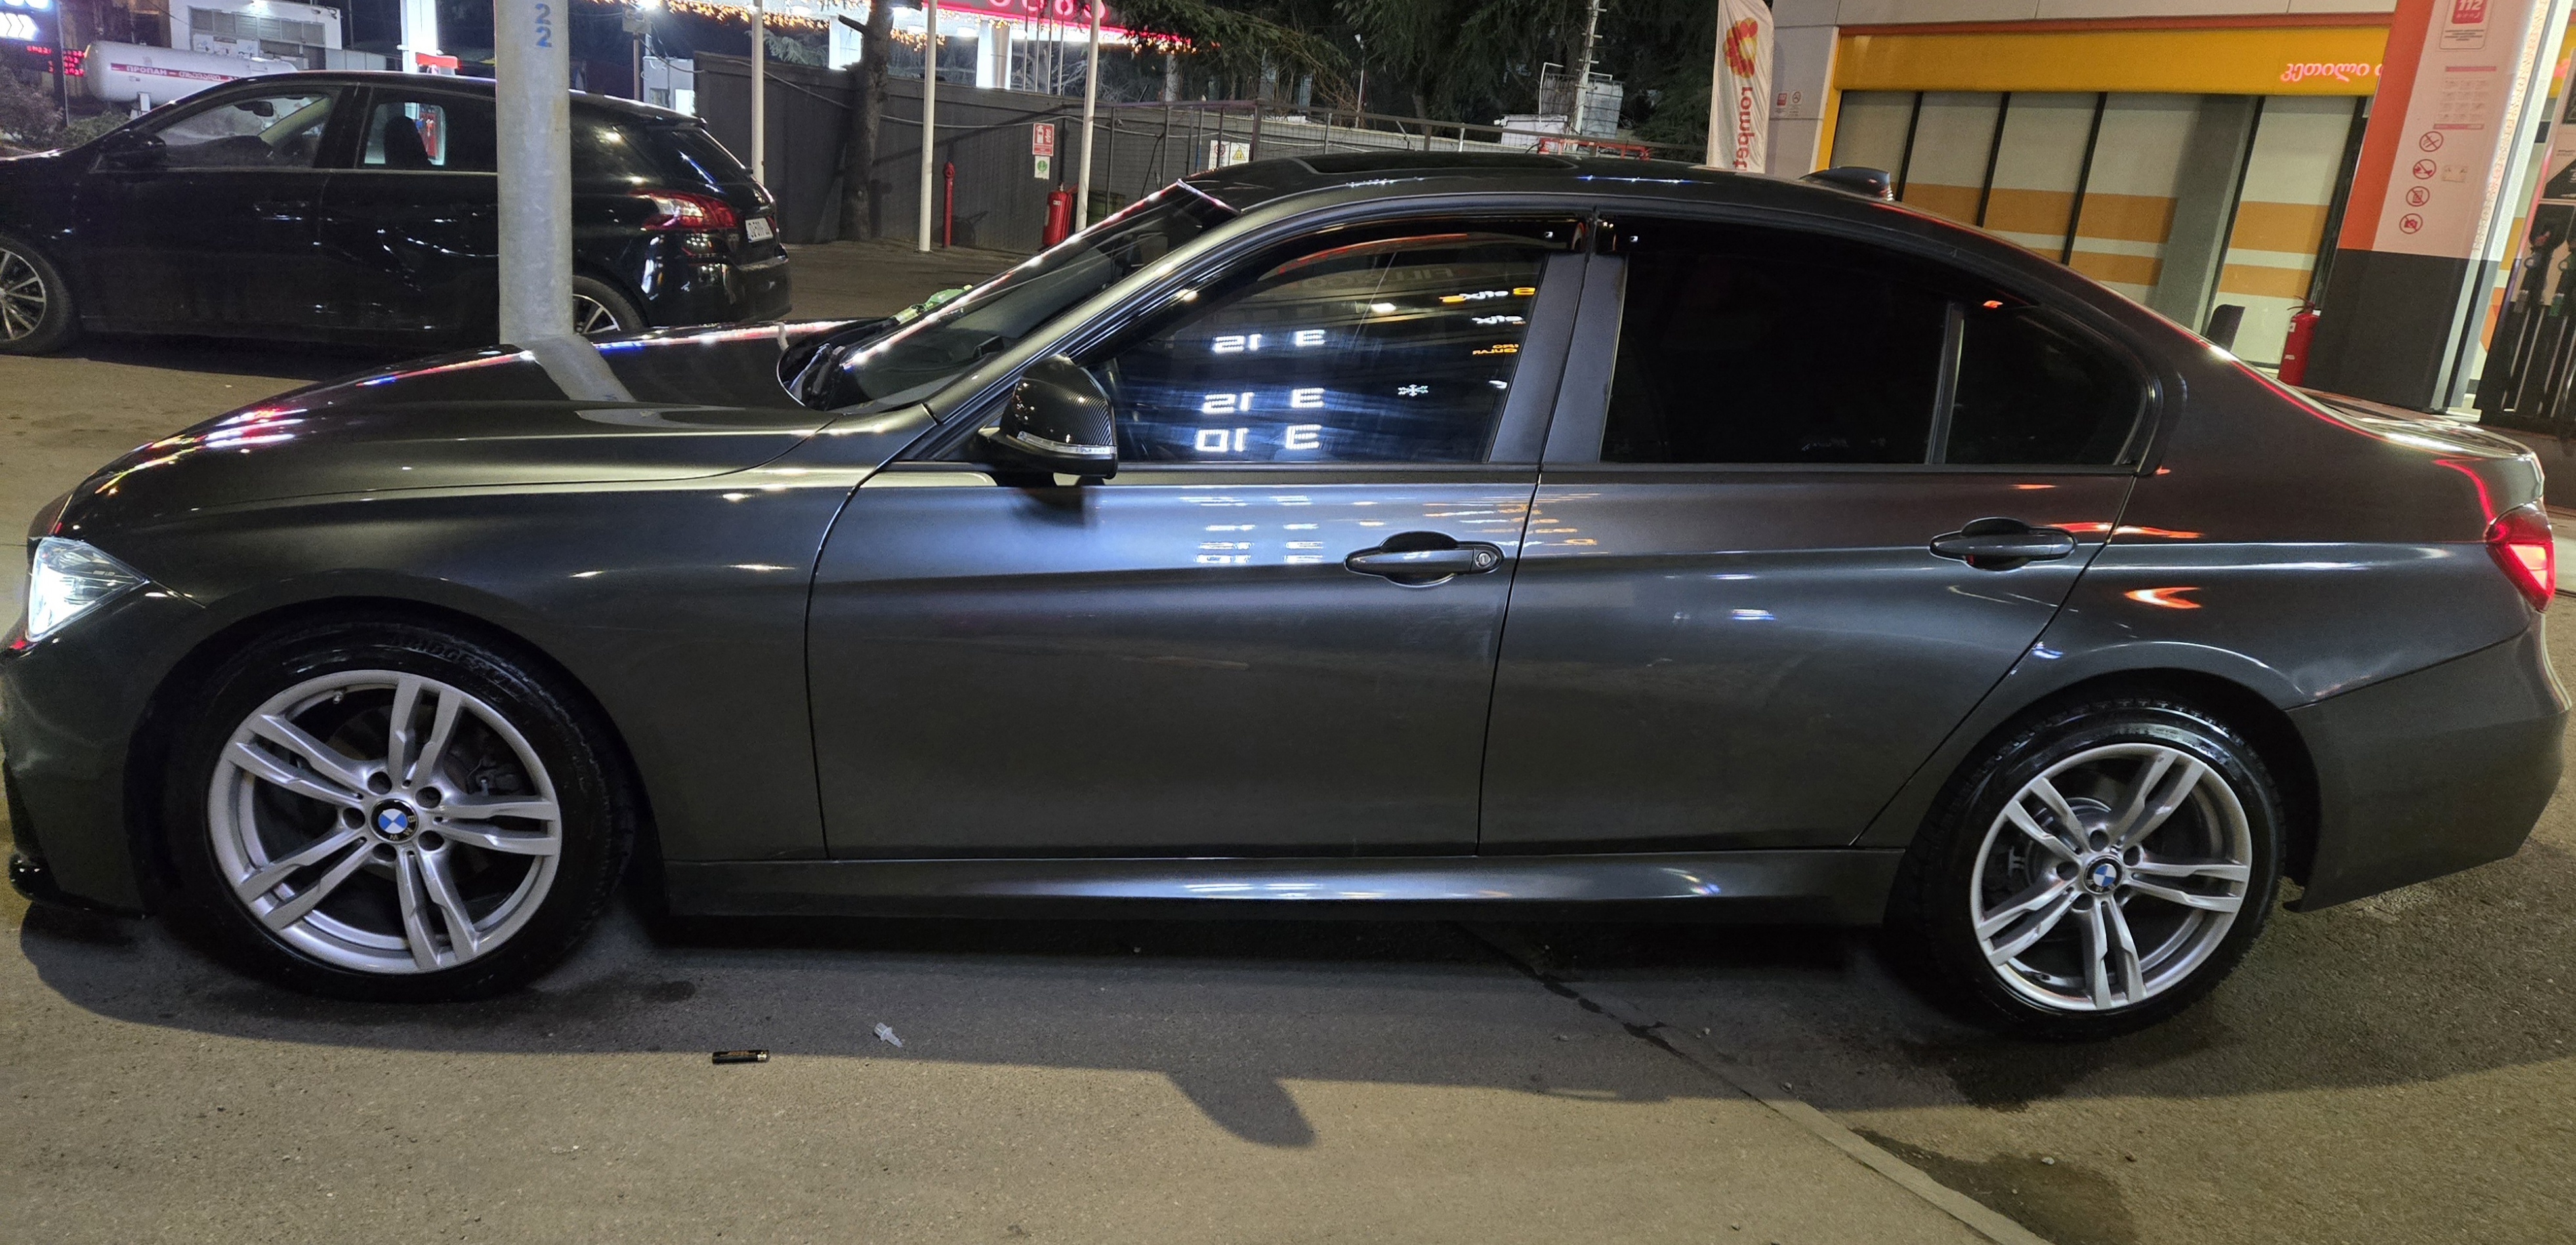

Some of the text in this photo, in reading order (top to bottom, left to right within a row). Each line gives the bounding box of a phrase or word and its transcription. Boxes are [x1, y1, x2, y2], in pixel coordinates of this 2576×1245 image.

[2458, 0, 2484, 10] 112
[127, 65, 167, 75] ПРОПАН
[2279, 63, 2370, 83] კეთილი
